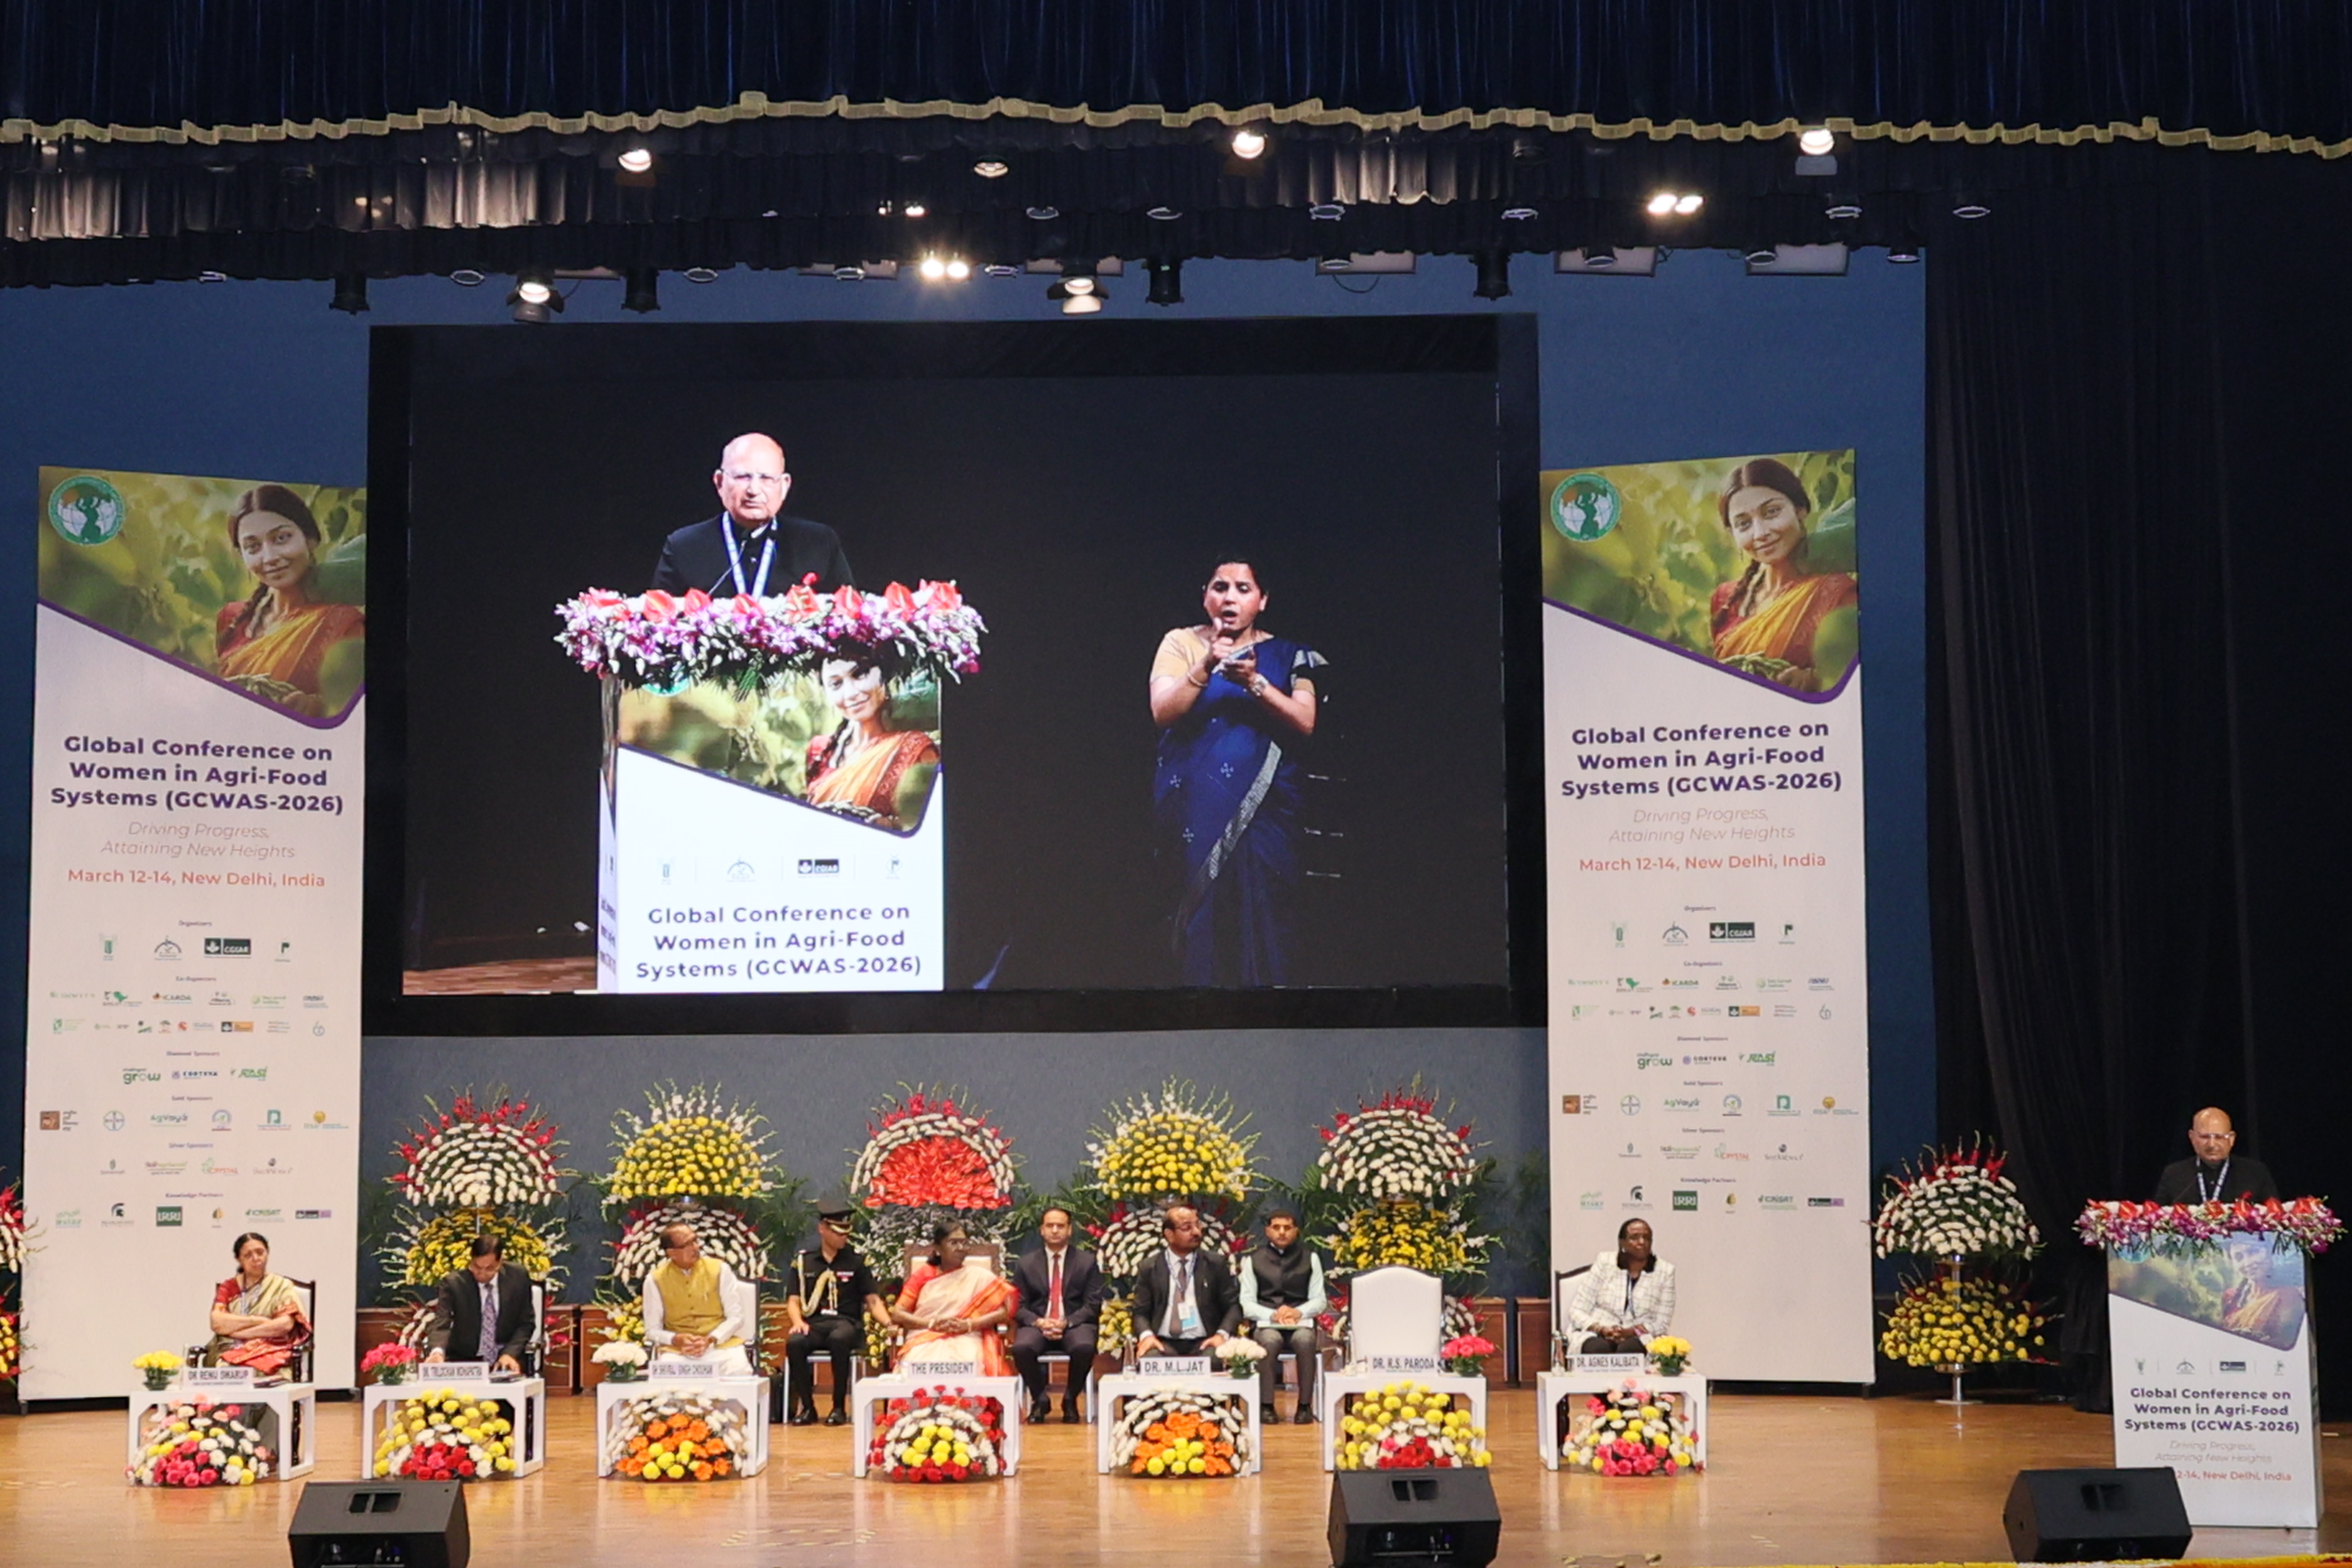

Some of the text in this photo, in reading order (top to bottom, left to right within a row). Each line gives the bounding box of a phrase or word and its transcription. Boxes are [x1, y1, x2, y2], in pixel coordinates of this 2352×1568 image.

[1572, 724, 1829, 745] Global Conference on
[64, 736, 332, 761] Global Conference on
[1577, 746, 1824, 770] Women in Agri-Food
[70, 762, 327, 787] Women in Agri-Food
[1562, 771, 1842, 799] Systems (GCWAS-2026)
[51, 787, 344, 815] Systems (GCWAS-2026)
[1633, 808, 1769, 824] Driving Progress,
[128, 822, 269, 839] Driving Progress,
[1609, 826, 1795, 844] Attaining New Heights
[101, 840, 295, 860] Attaining New Heights
[1579, 853, 1826, 871] March 12-14, New Delhi, India
[68, 869, 325, 888] March 12-14, New Delhi, India
[648, 906, 910, 923] Global Conference on
[654, 930, 905, 952] Women in Agri-Food
[636, 962, 738, 981] Systems
[746, 956, 921, 979] (GCWAS-2026)
[1637, 1057, 1672, 1069] grow
[123, 1072, 161, 1085] grow
[1674, 1195, 1696, 1206] IRRI
[912, 1362, 974, 1375] THE PRESIDENT
[1145, 1361, 1162, 1373] DR.
[1404, 1357, 1434, 1369] PARODA
[2130, 1388, 2291, 1400] Global Conference on
[2134, 1403, 2289, 1417] Women in Agri-Food
[2125, 1419, 2299, 1434] Systems (GCWAS-2026)
[2175, 1471, 2200, 1480] 2-14,
[2203, 1471, 2228, 1479] New
[2264, 1473, 2292, 1481] India
